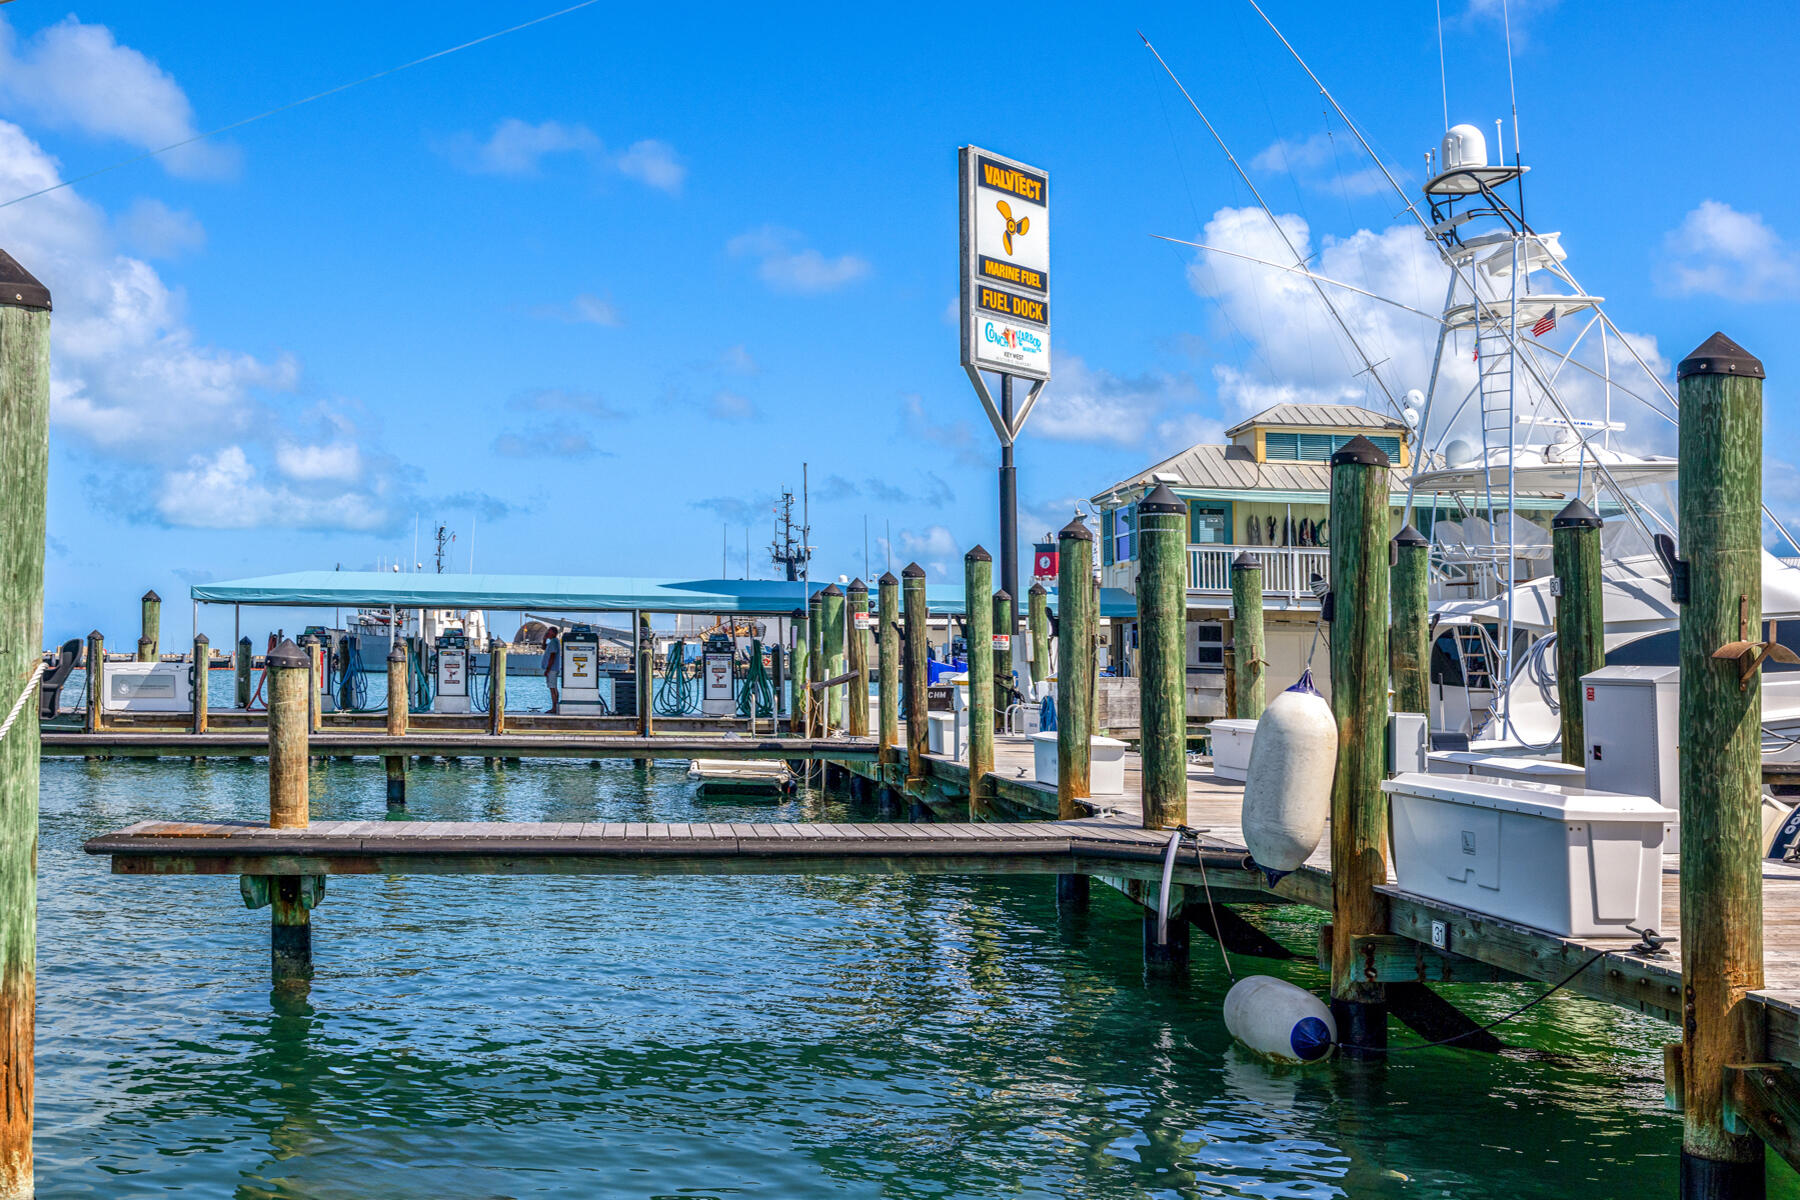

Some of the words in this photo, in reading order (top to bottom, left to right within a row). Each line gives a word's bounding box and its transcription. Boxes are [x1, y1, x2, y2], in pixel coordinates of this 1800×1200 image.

[983, 163, 1042, 201] VALVTECT
[984, 259, 1020, 282] MARINE
[1020, 269, 1042, 288] FUEL
[982, 288, 1011, 313] FUEL
[1012, 297, 1044, 321] DOCK
[1434, 926, 1444, 944] 31
